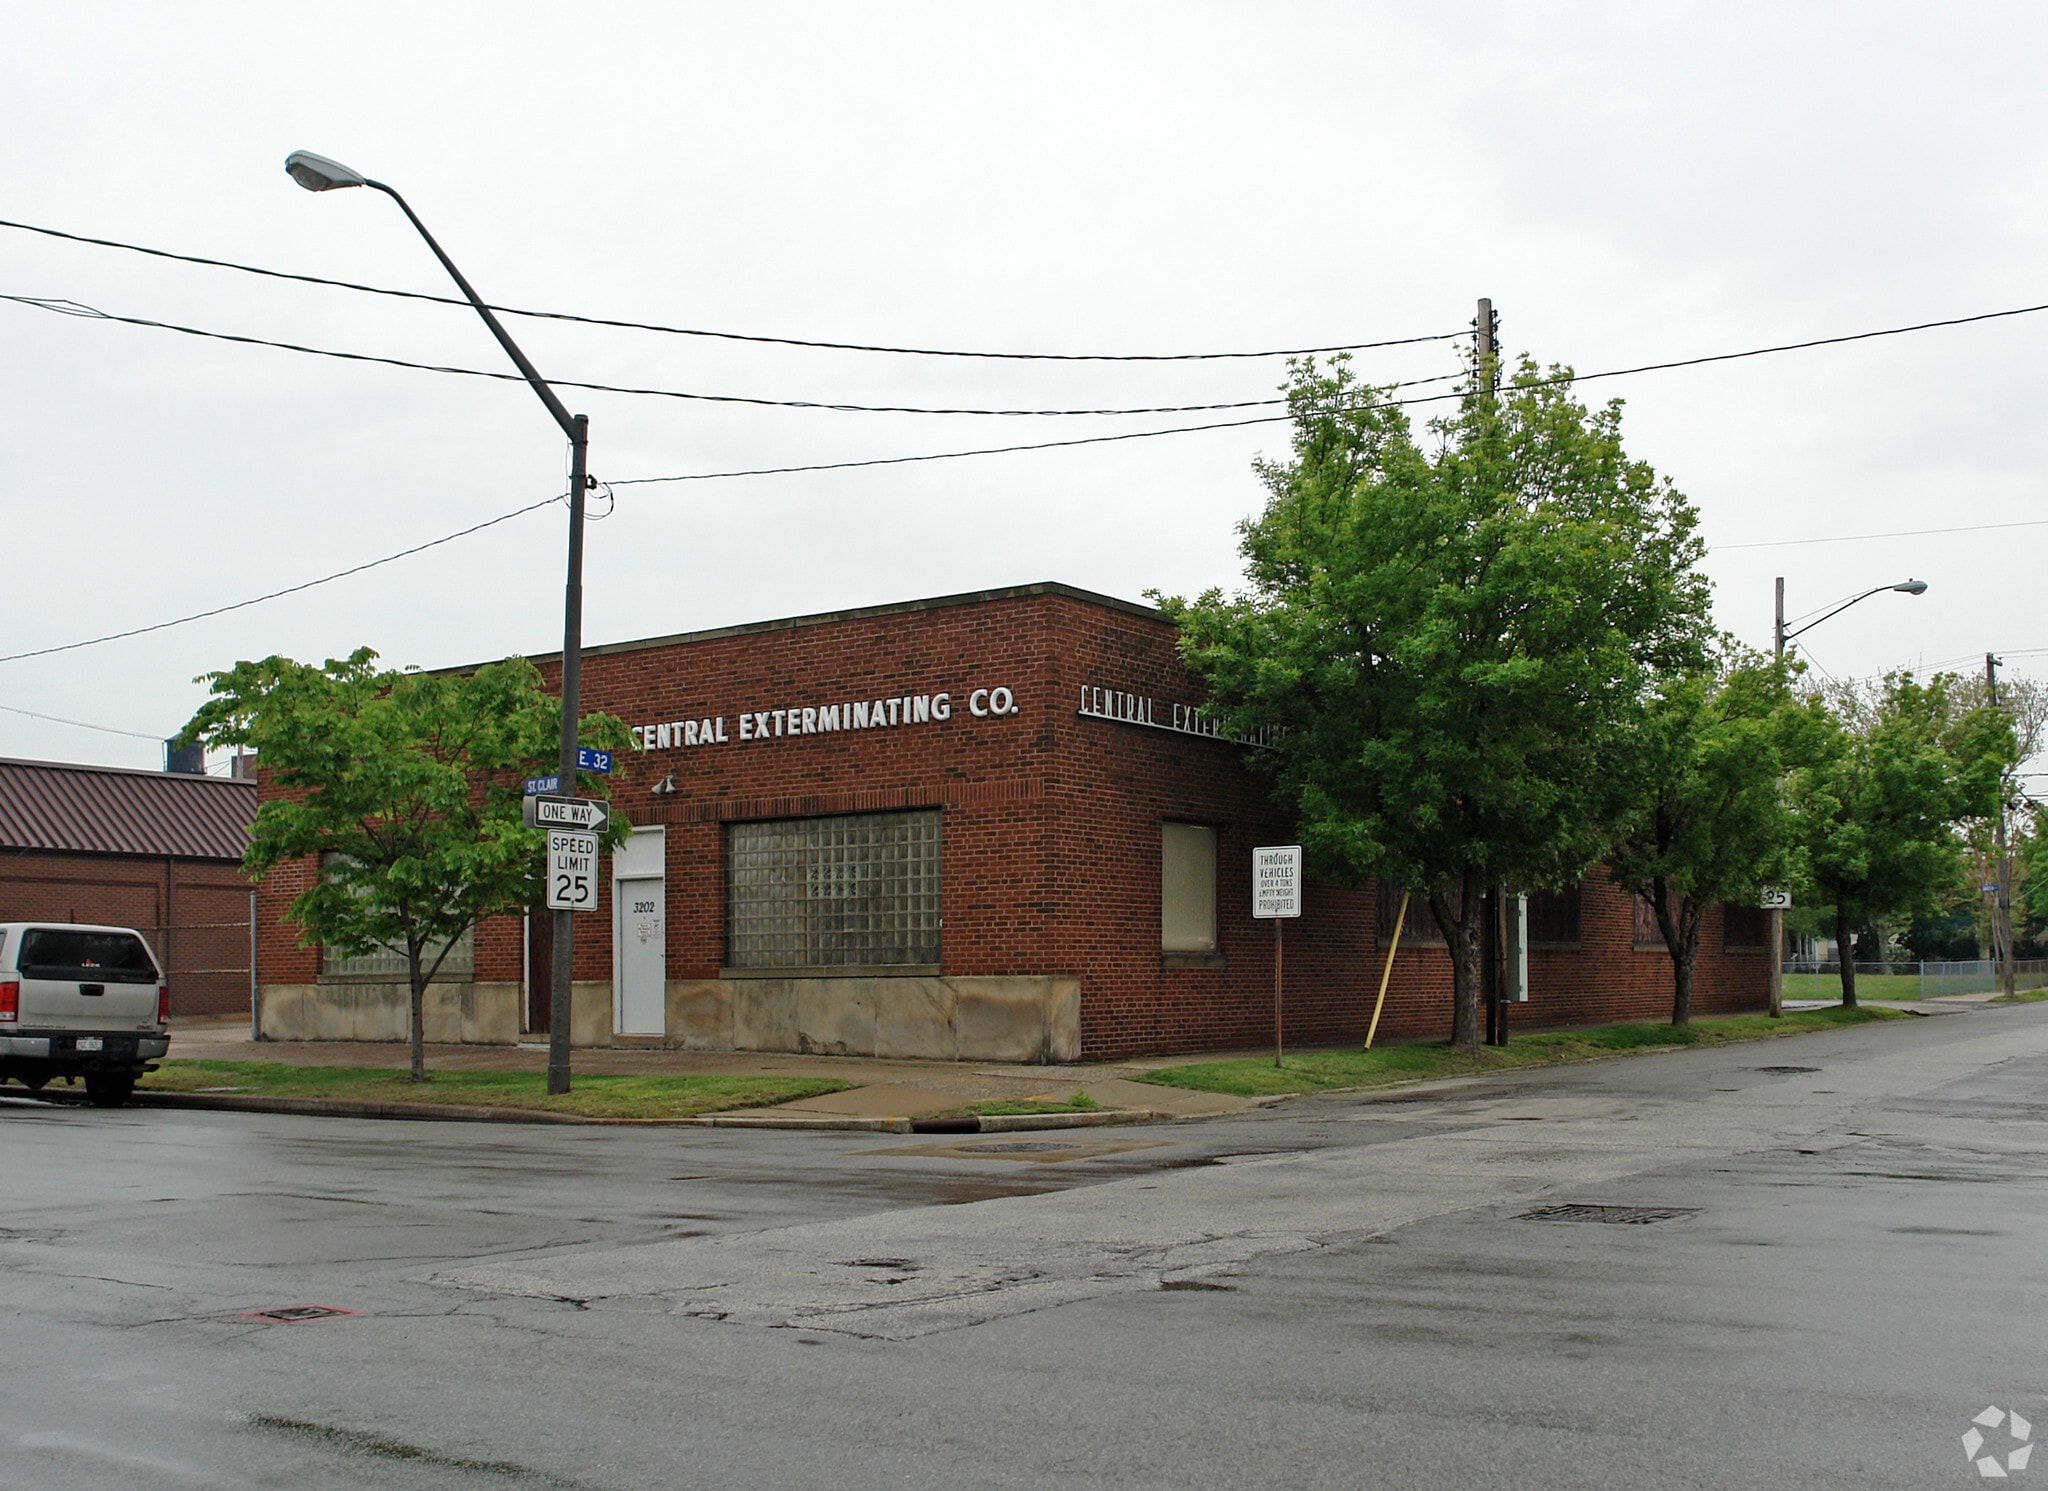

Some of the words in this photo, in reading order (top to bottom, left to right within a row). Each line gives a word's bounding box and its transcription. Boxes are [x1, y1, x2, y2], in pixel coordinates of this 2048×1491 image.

[1080, 684, 1156, 725] CENTRAL
[631, 716, 729, 751] CENTRAL
[740, 692, 951, 740] EXTERMINATING
[968, 686, 1020, 718] CO.
[579, 751, 589, 766] E.
[593, 753, 608, 770] 32
[538, 777, 558, 792] CLAIR
[543, 804, 566, 820] ONE
[571, 806, 593, 823] WAY
[552, 837, 594, 854] SPEED
[557, 855, 591, 872] LIMIT
[1260, 854, 1293, 865] THROUGH
[1260, 867, 1293, 878] VEHICLES
[556, 874, 589, 903] 25
[1261, 879, 1274, 888] OVER
[1275, 879, 1279, 887] 4
[1280, 879, 1293, 887] TONS
[1259, 898, 1294, 910] PROHIBITED
[1767, 890, 1786, 904] 25
[633, 901, 655, 914] 3202
